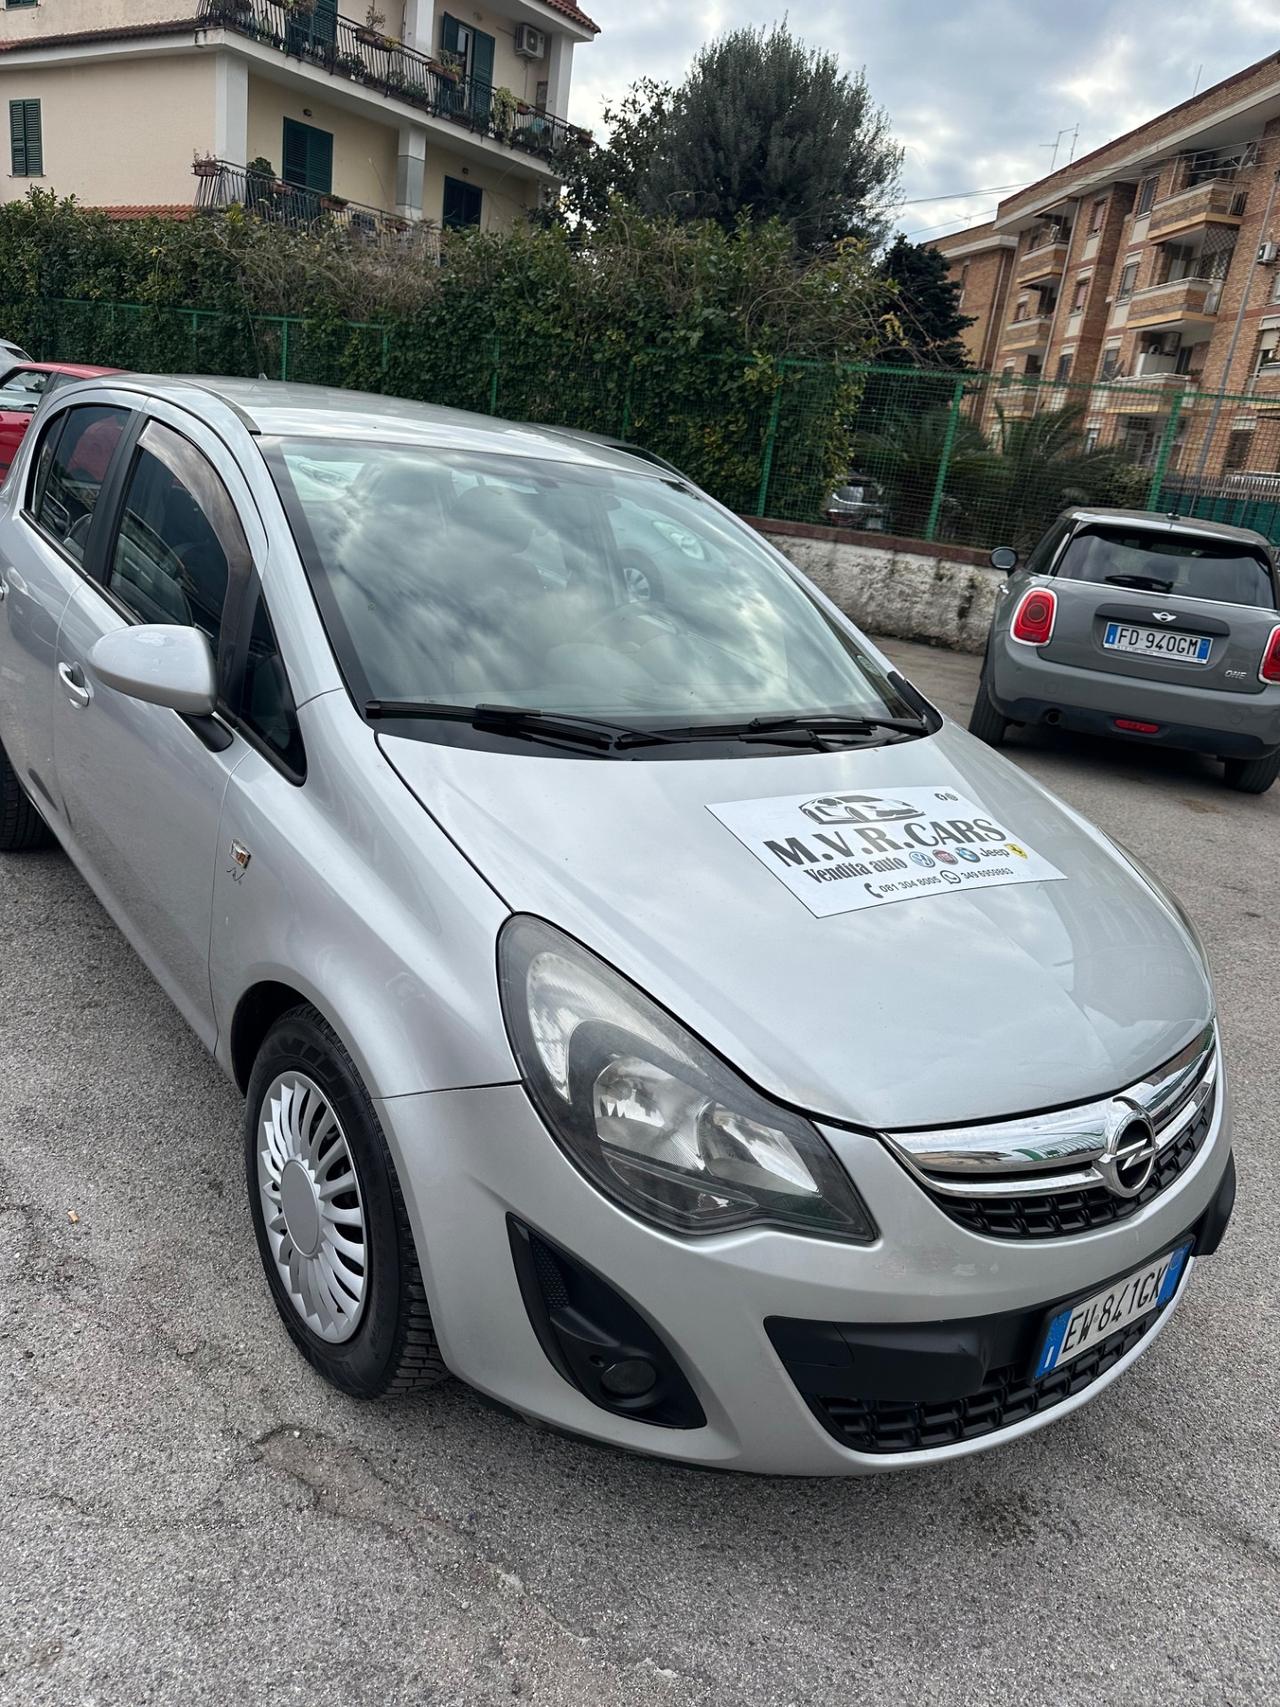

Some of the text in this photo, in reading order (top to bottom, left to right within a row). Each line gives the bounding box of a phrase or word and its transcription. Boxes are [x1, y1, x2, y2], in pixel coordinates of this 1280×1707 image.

[1224, 669, 1248, 680] ONE
[979, 847, 1010, 858] Jeep
[803, 861, 871, 884] Vendita
[869, 855, 908, 876] auto
[960, 871, 979, 879] 349
[879, 883, 900, 892] 081
[898, 880, 918, 889] 304
